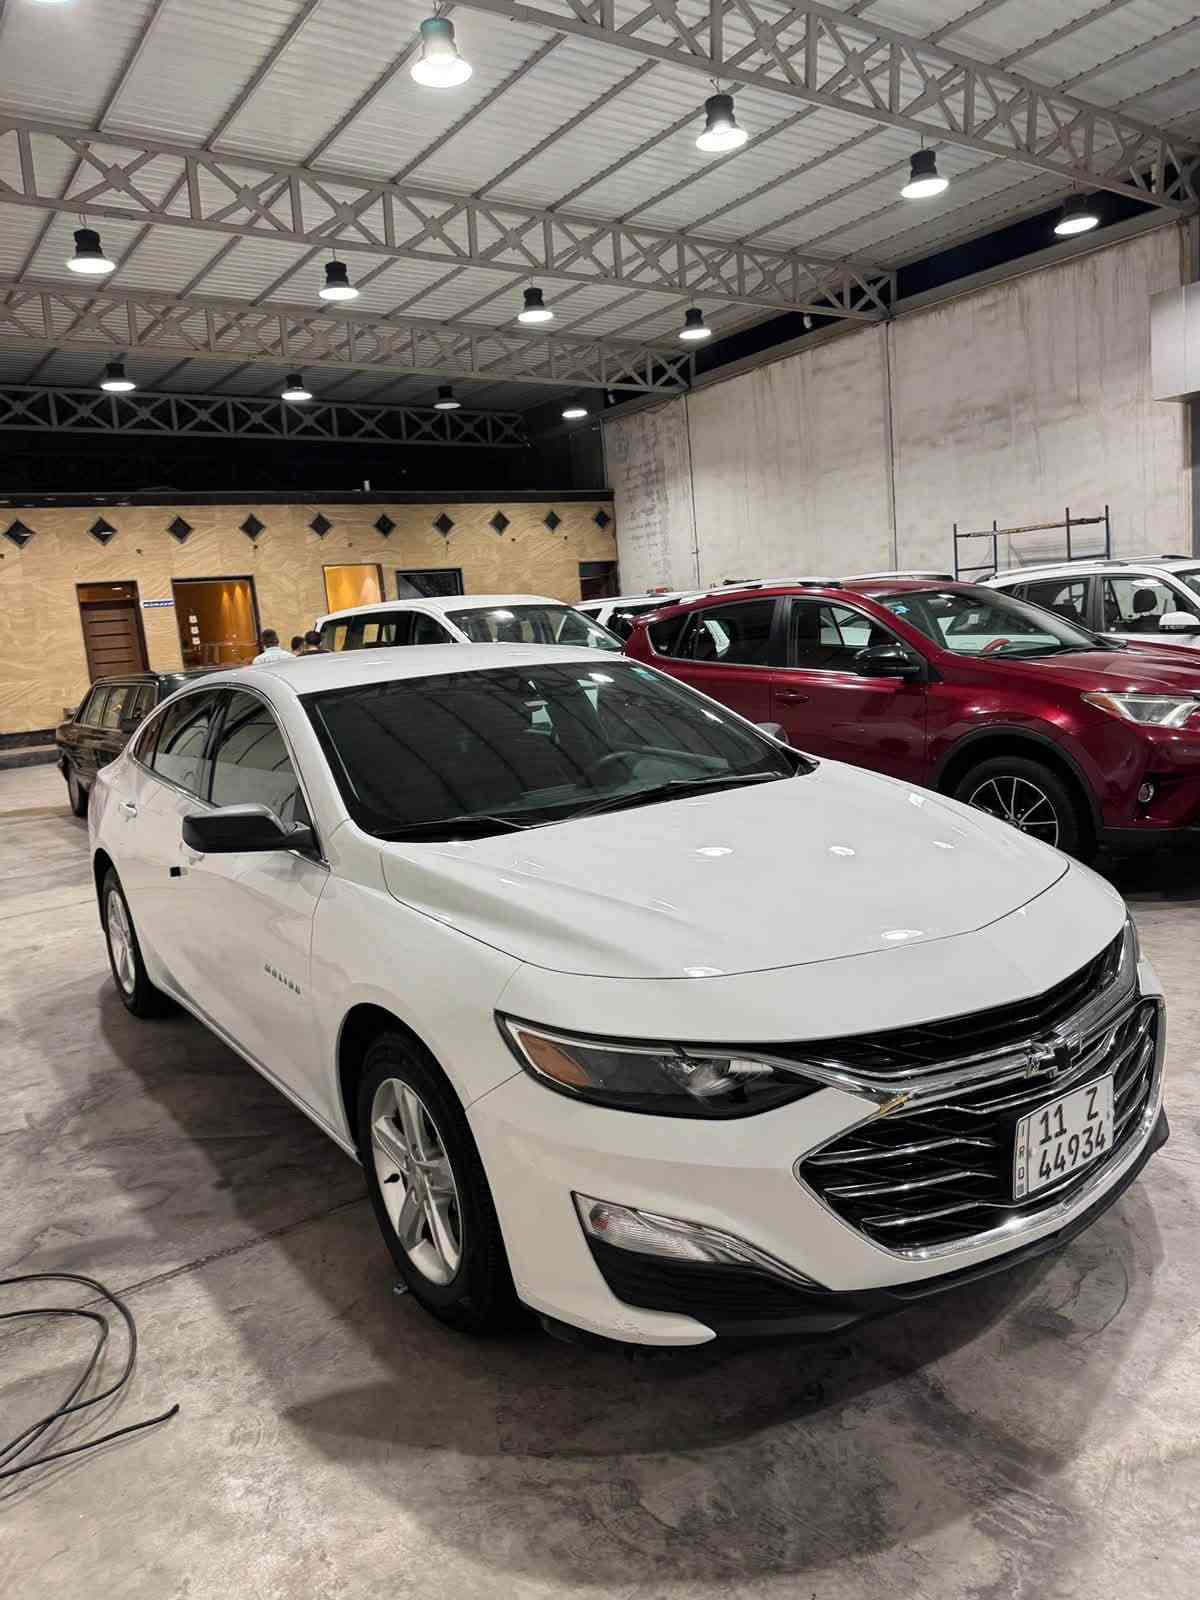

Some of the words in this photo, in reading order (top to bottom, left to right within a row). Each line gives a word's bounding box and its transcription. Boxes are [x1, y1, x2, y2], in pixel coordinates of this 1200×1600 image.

[1039, 1104, 1067, 1145] 11
[1085, 1086, 1099, 1121] Z
[1039, 1120, 1106, 1180] 44934
